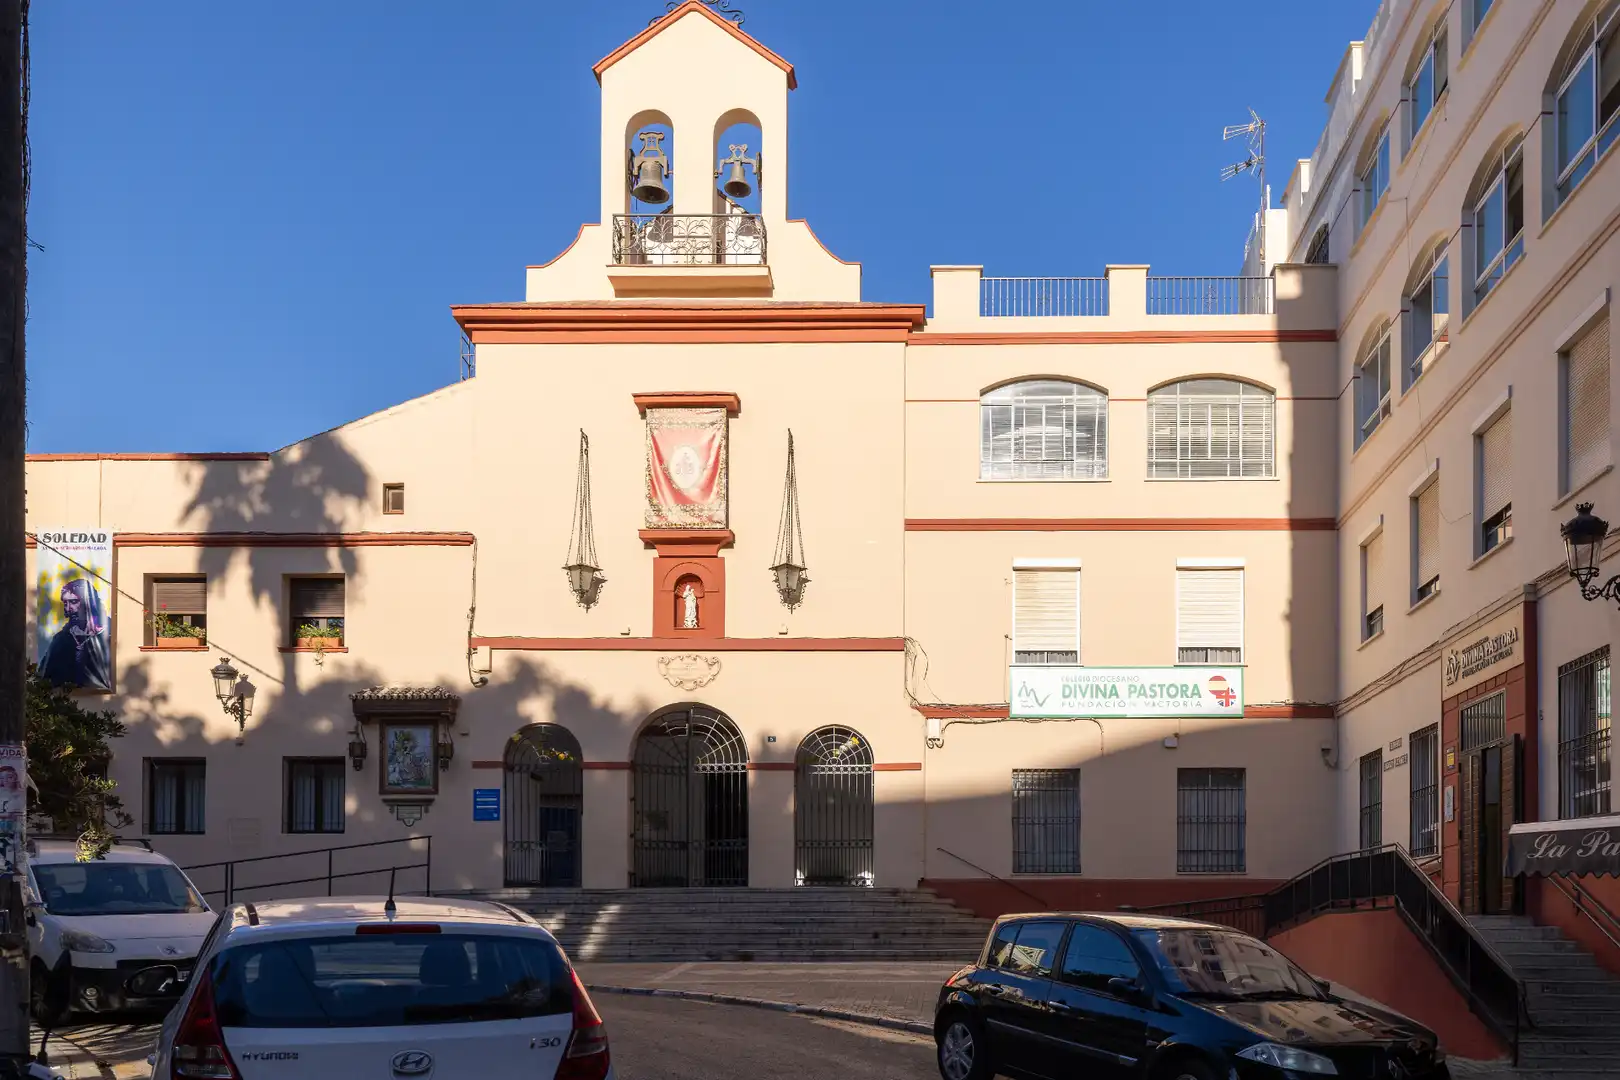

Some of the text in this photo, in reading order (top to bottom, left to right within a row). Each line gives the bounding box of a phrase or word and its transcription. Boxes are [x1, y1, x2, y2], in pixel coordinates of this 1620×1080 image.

[42, 532, 107, 543] SOLEDAD
[1461, 644, 1485, 669] DIVINA
[1485, 627, 1519, 657] PASTORA
[1062, 683, 1202, 699] DIVINA PASTORA
[1526, 833, 1573, 859] La
[241, 1050, 299, 1061] HYUNDAI
